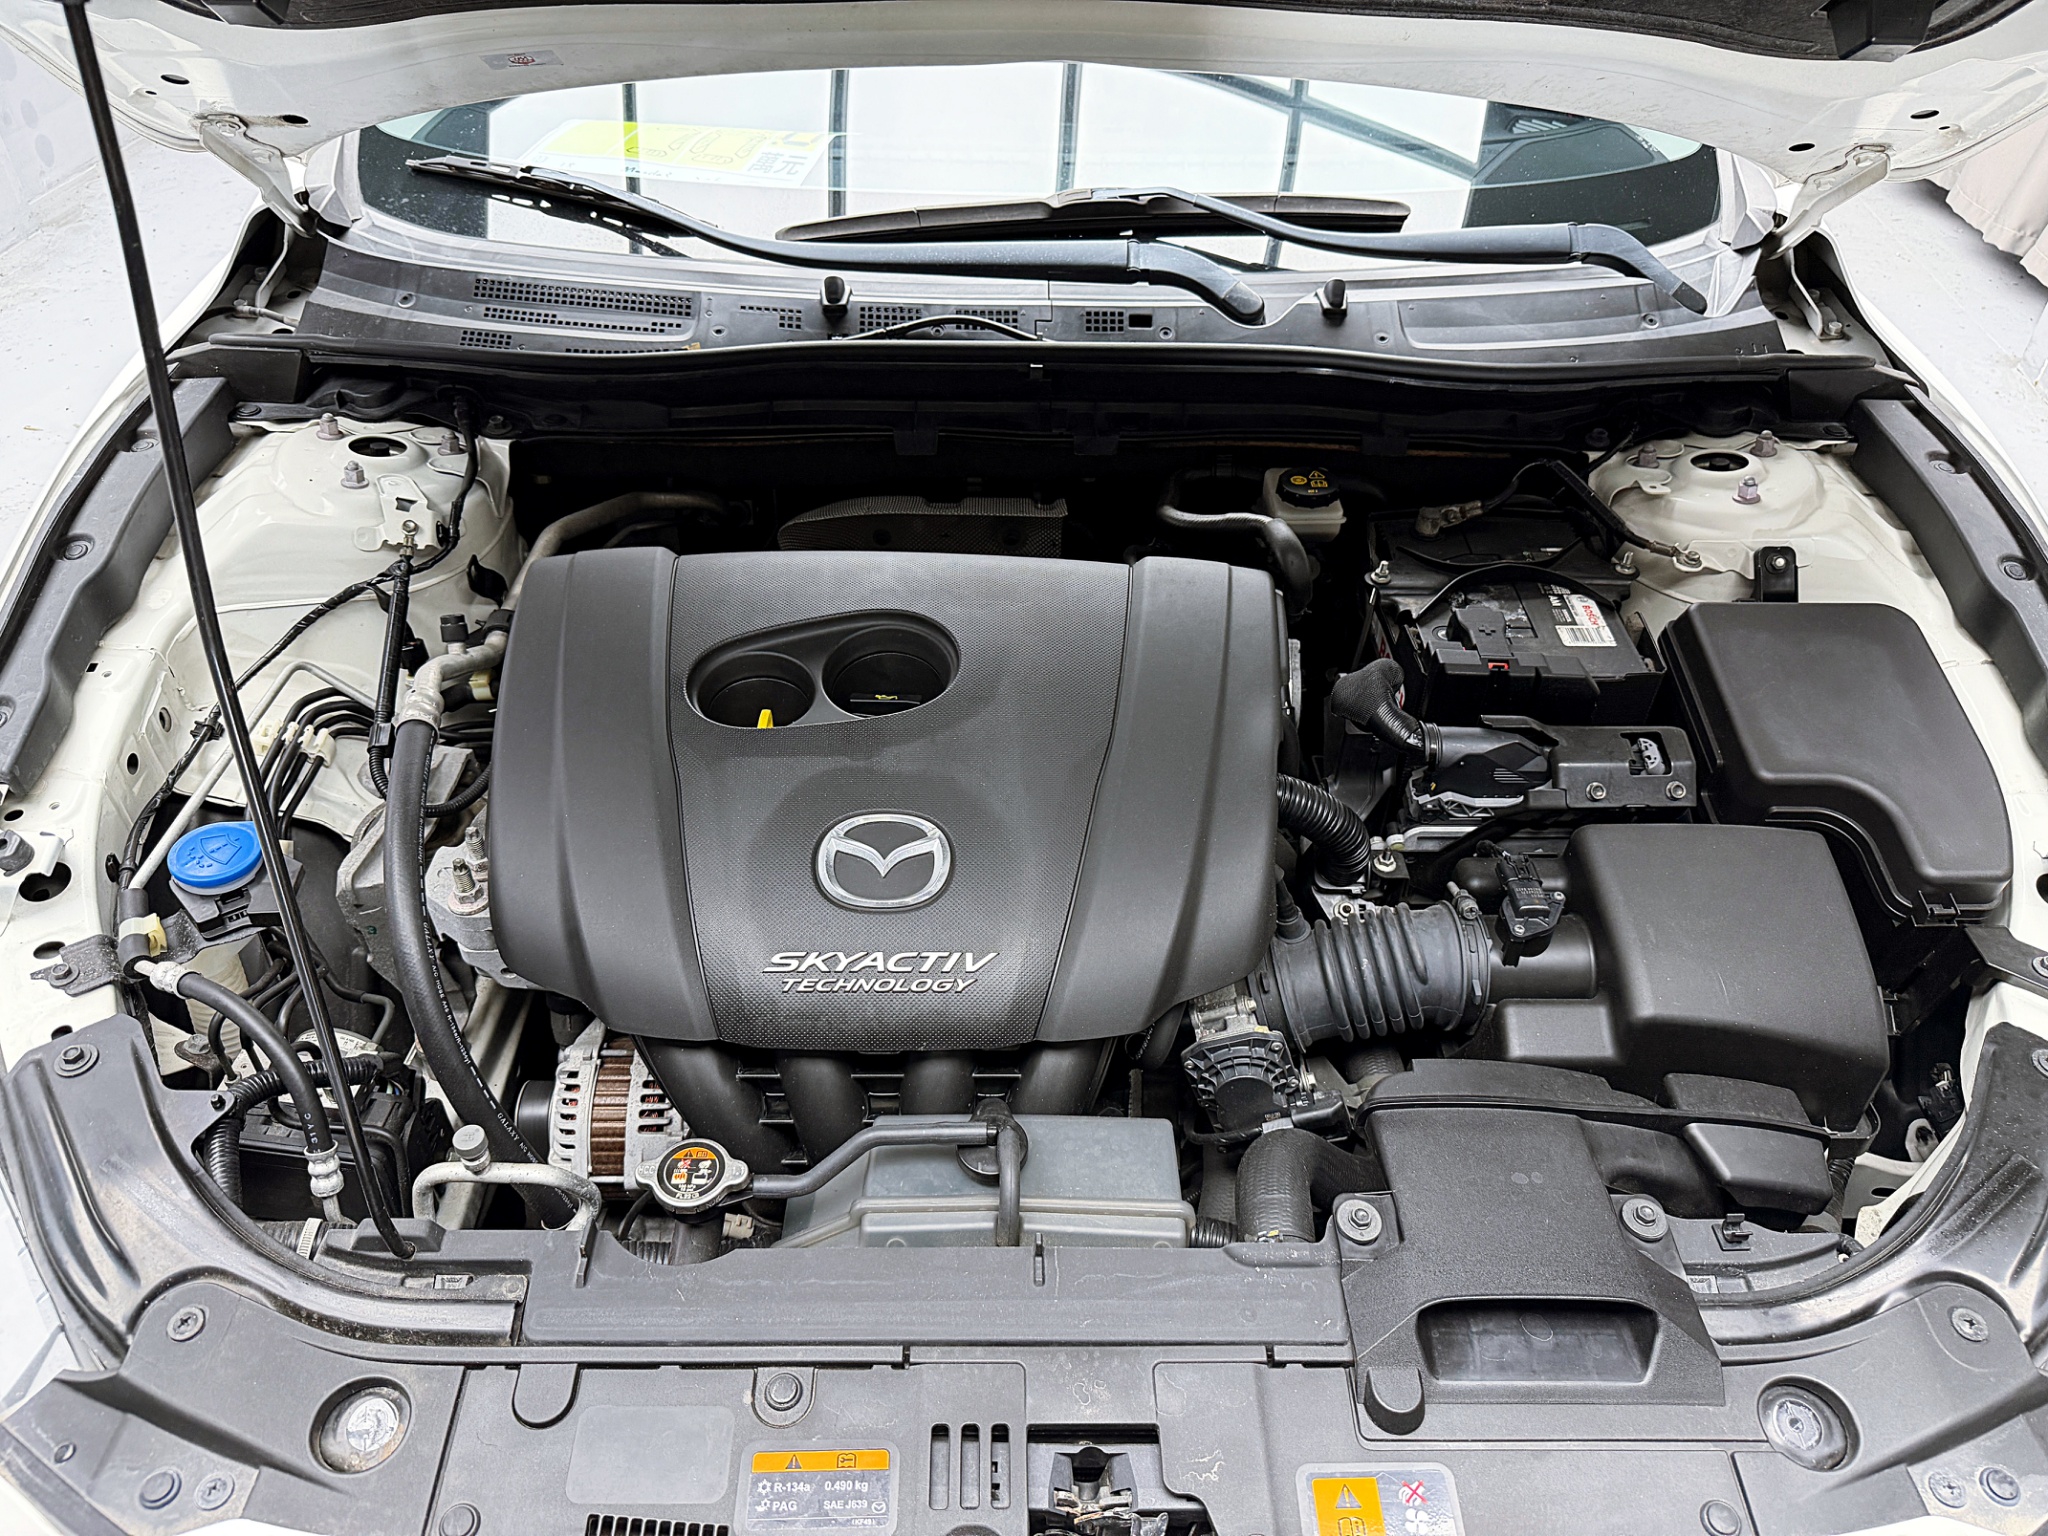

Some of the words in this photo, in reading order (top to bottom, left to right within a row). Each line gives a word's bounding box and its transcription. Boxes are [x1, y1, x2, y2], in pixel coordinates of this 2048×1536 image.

[1582, 605, 1600, 626] BOSCH
[423, 922, 435, 963] GALAXY
[762, 951, 1000, 973] SKYACTIV
[782, 978, 978, 994] TECHNOLOGY
[497, 1112, 520, 1141] GALAXY
[773, 1481, 811, 1493] R-134a
[824, 1480, 852, 1491] 0.490
[855, 1480, 869, 1493] kg
[772, 1501, 798, 1511] PAG
[823, 1500, 844, 1509] SAE
[845, 1499, 868, 1509] J639
